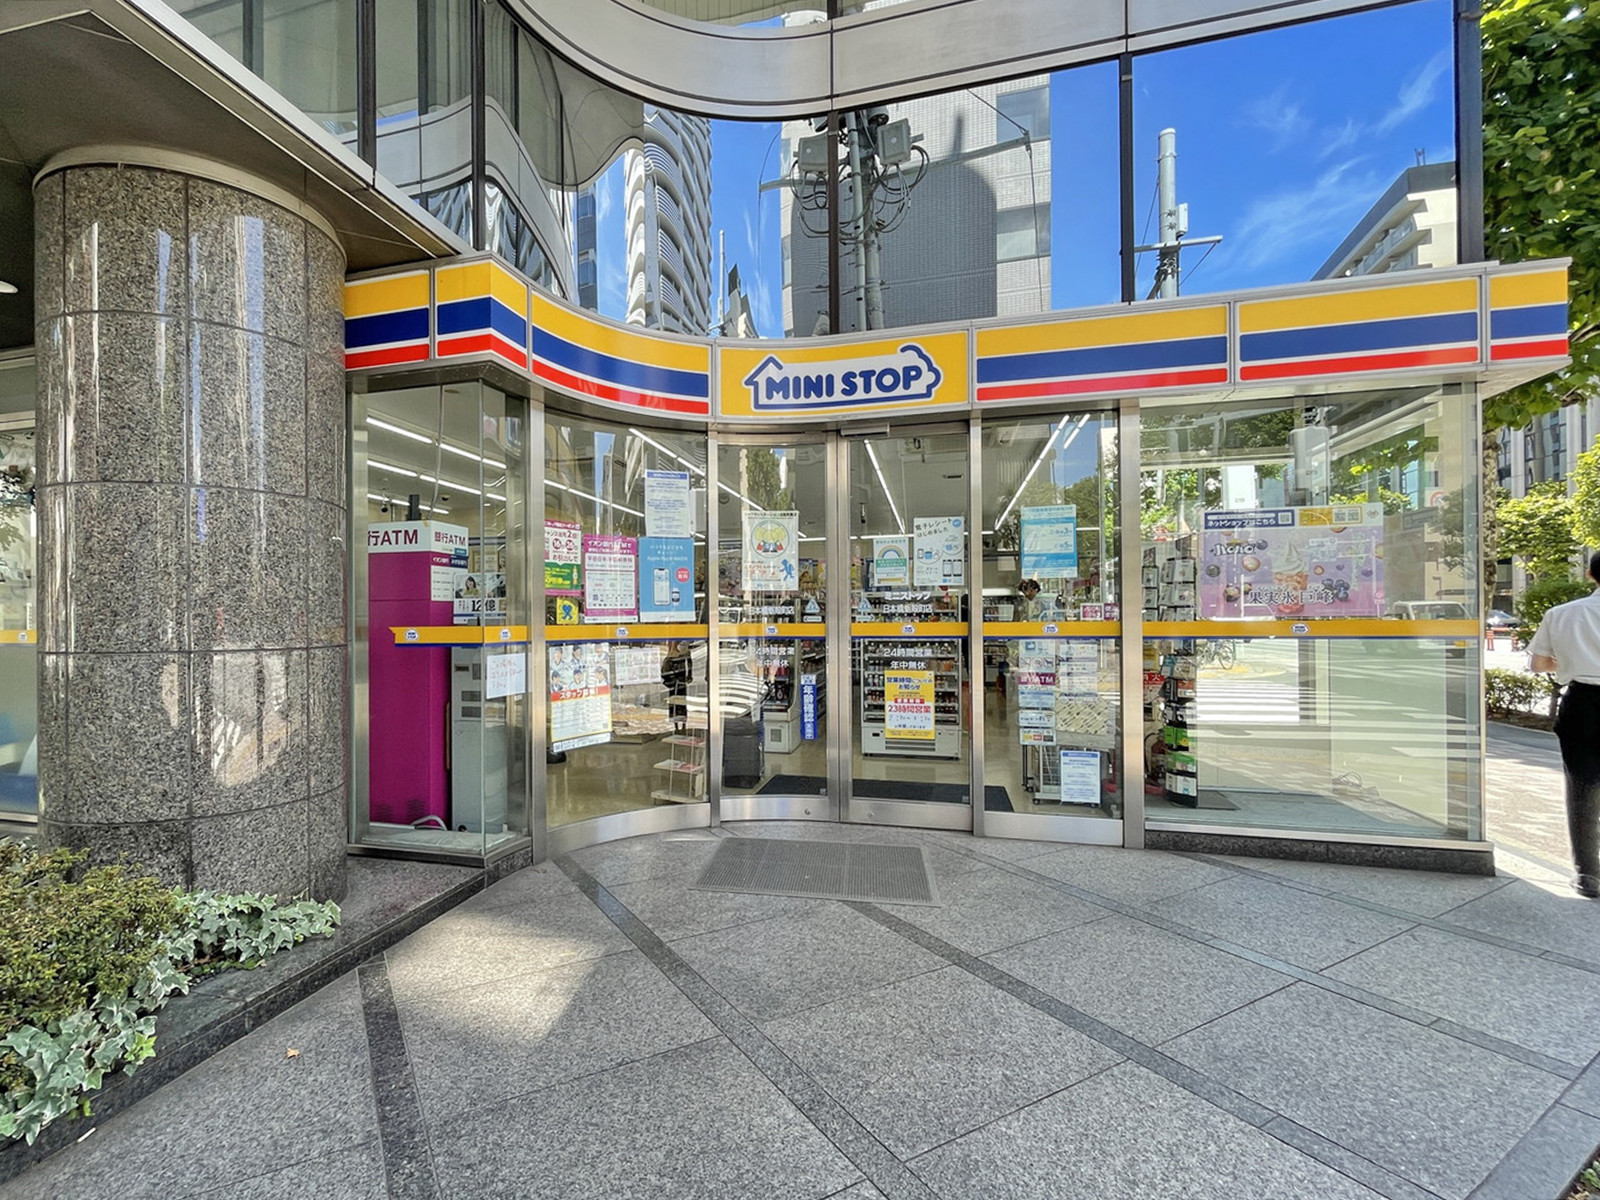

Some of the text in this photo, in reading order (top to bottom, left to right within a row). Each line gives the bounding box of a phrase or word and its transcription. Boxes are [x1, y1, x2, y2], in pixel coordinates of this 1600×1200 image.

[765, 365, 922, 400] MINI STOP
[884, 591, 932, 601] ミニストップ
[1249, 590, 1334, 604] 果実氷 巨峰
[471, 599, 496, 612] 12億
[883, 648, 933, 657] 24時間営業
[890, 660, 927, 670] 年中無休
[888, 705, 931, 713] 23時間営業
